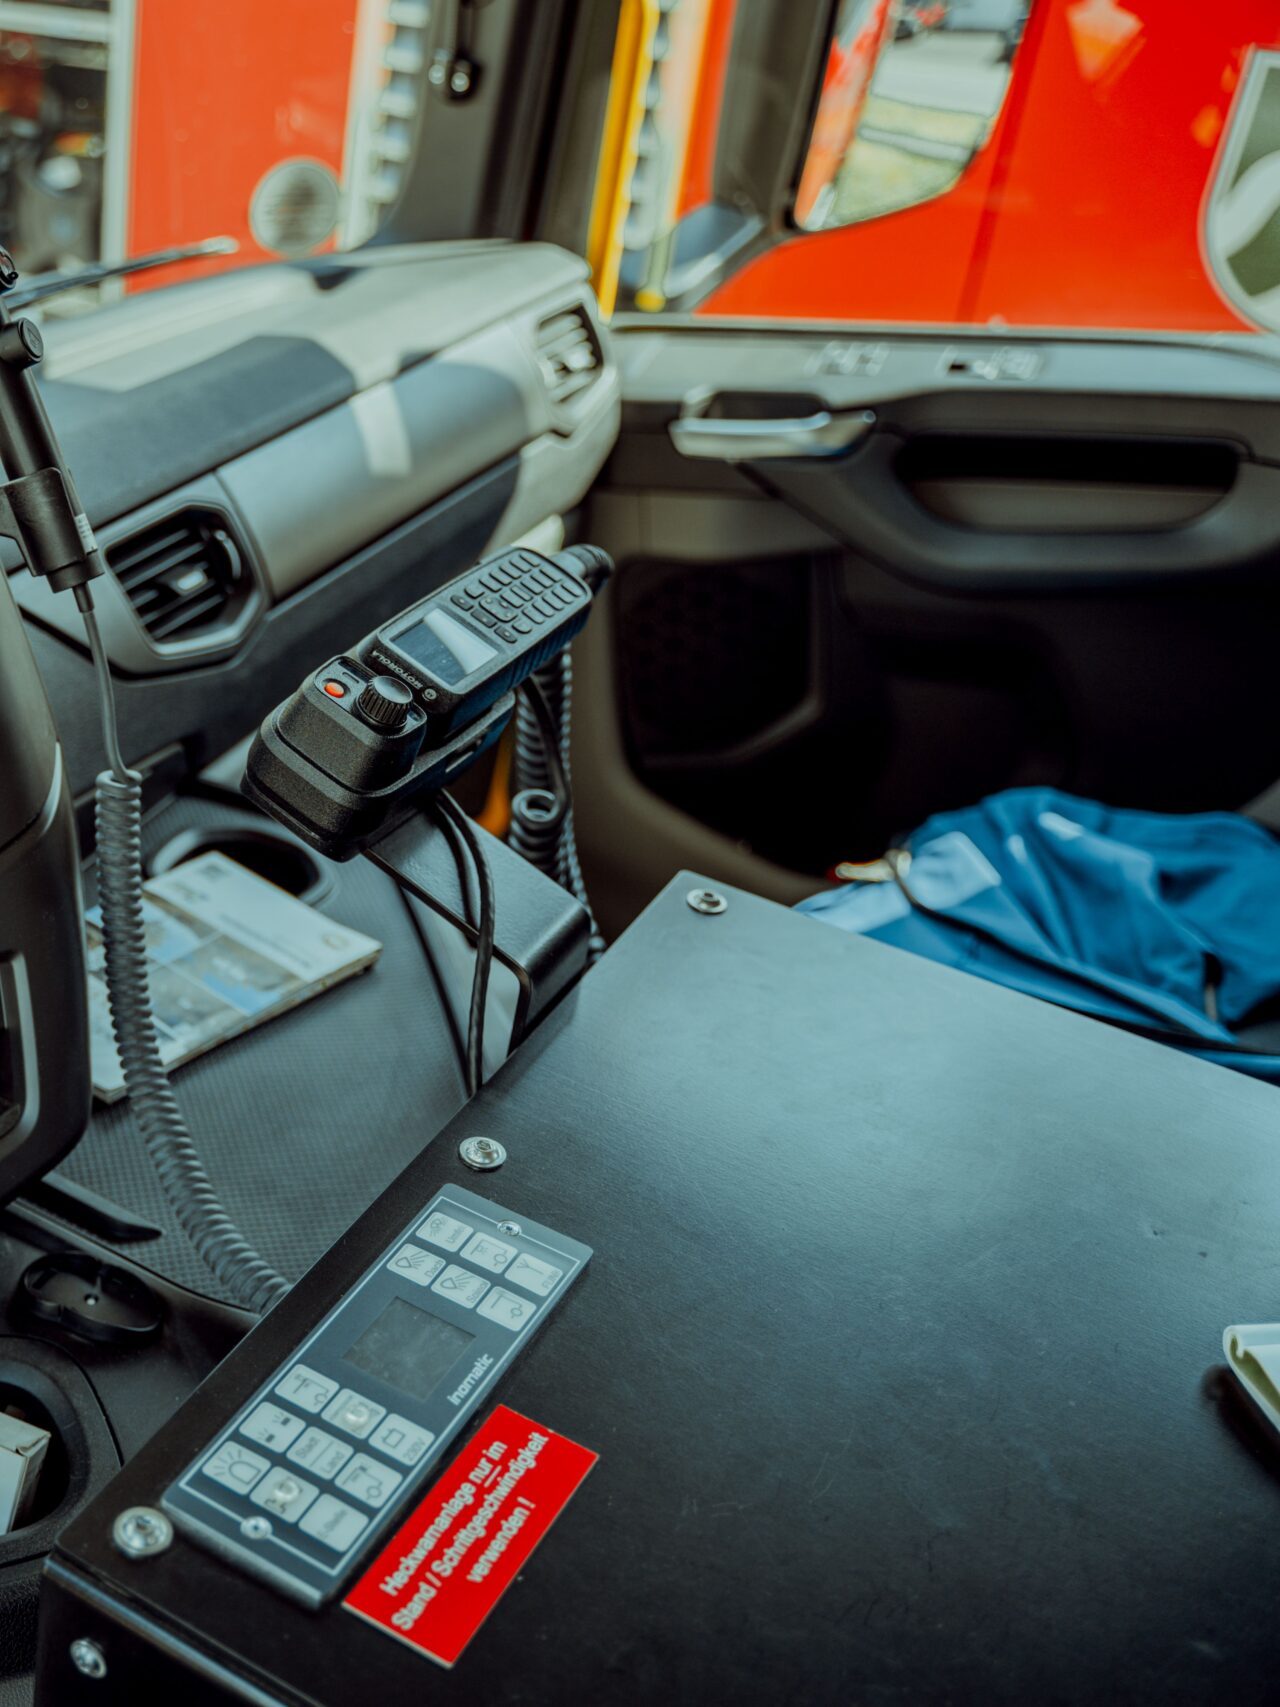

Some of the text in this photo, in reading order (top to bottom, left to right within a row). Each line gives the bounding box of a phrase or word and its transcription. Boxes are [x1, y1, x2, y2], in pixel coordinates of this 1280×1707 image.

[371, 650, 424, 690] MOTOROLA
[378, 1440, 508, 1597] Heckwarnanlage nur im
[391, 1431, 550, 1631] Stand / Schrittgeschwindigkeit
[466, 1506, 531, 1583] verwenden
